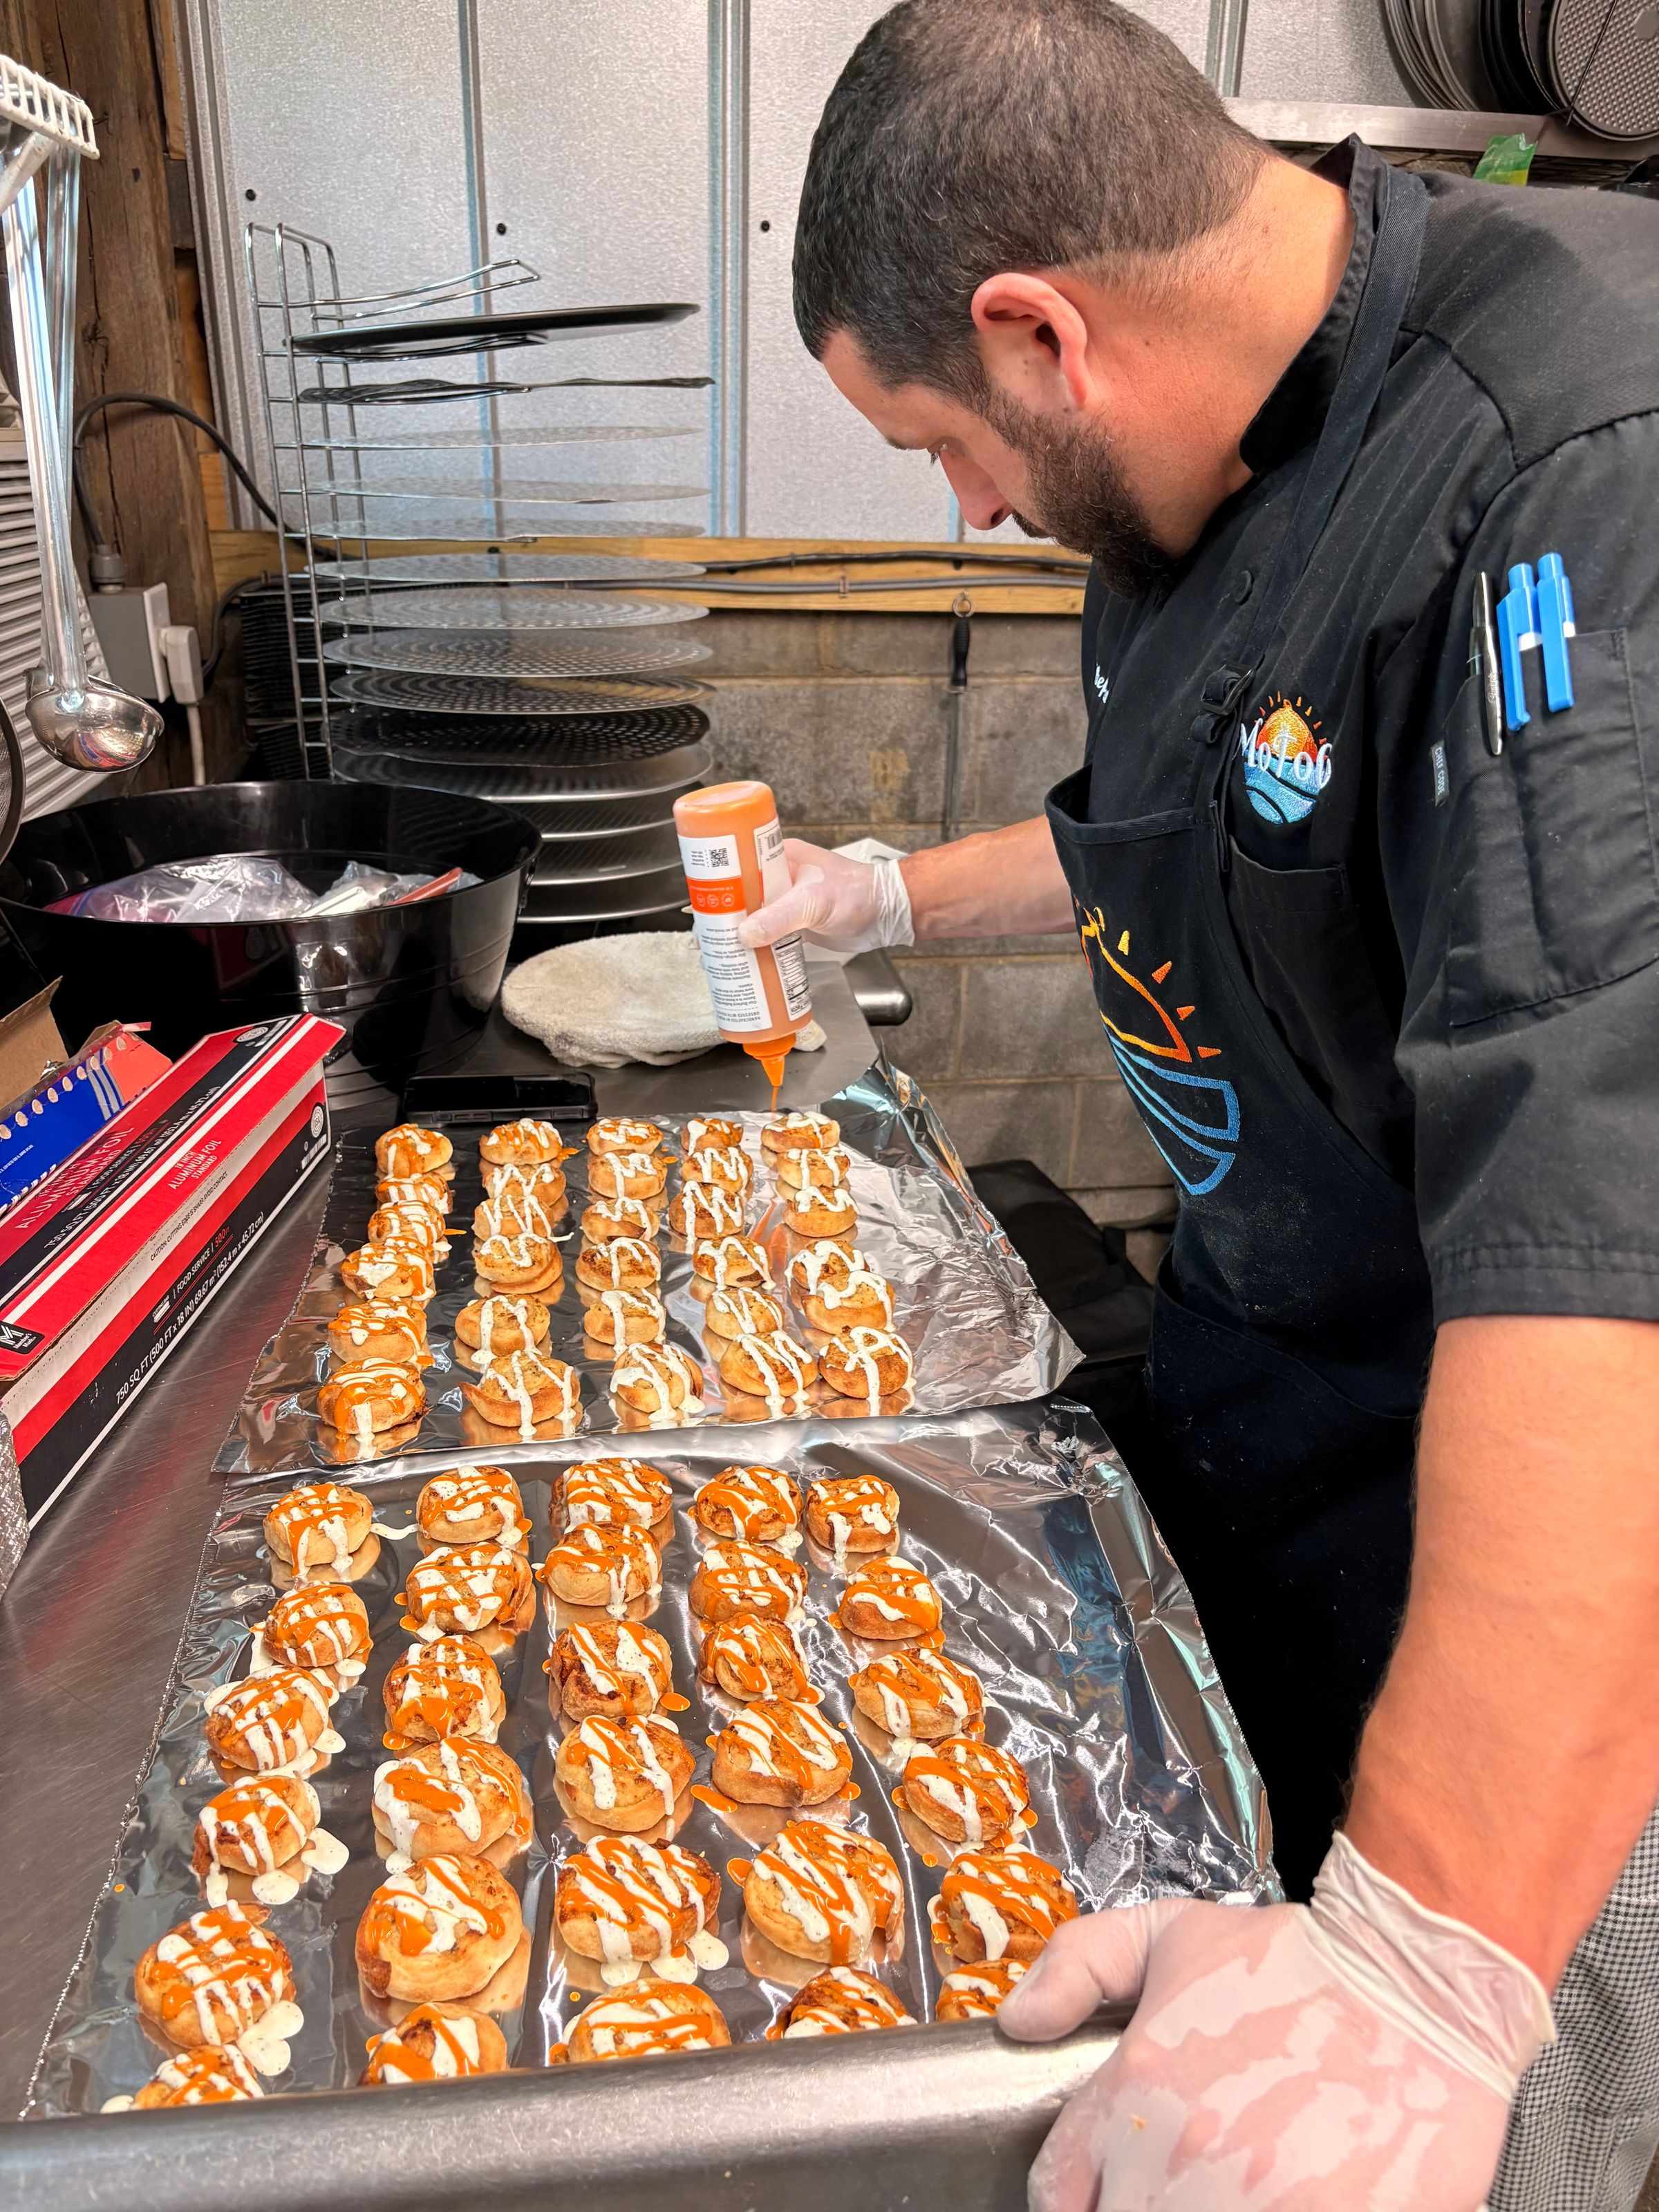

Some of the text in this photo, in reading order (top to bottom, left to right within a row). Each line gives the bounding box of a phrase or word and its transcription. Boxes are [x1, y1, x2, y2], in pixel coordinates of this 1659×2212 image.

[1434, 747, 1443, 769] CHEF
[15, 1127, 135, 1228] ALUMINUM FOIL
[66, 1149, 122, 1197] STANDARD
[168, 1140, 222, 1190] ALUMINUM FOIL
[174, 1151, 197, 1170] 18 INCH
[191, 1155, 218, 1179] STANDARD
[167, 1222, 182, 1243] CUTTING
[203, 1186, 214, 1200] AVOID
[44, 1232, 66, 1248] 750
[177, 1272, 192, 1293] FOOD
[191, 1248, 211, 1275] SERVICE
[115, 1381, 129, 1405] 750
[129, 1368, 141, 1387] SQ
[140, 1355, 149, 1373] FT
[149, 1338, 164, 1363] (500
[163, 1327, 173, 1344] FT
[172, 1324, 178, 1333] x
[176, 1312, 185, 1327] 18
[184, 1300, 194, 1318] IN)
[194, 1279, 209, 1305] 69.67
[216, 1252, 232, 1278] (152.4
[231, 1246, 238, 1256] m
[241, 1222, 255, 1245] 45.72
[254, 1211, 265, 1229] cm)
